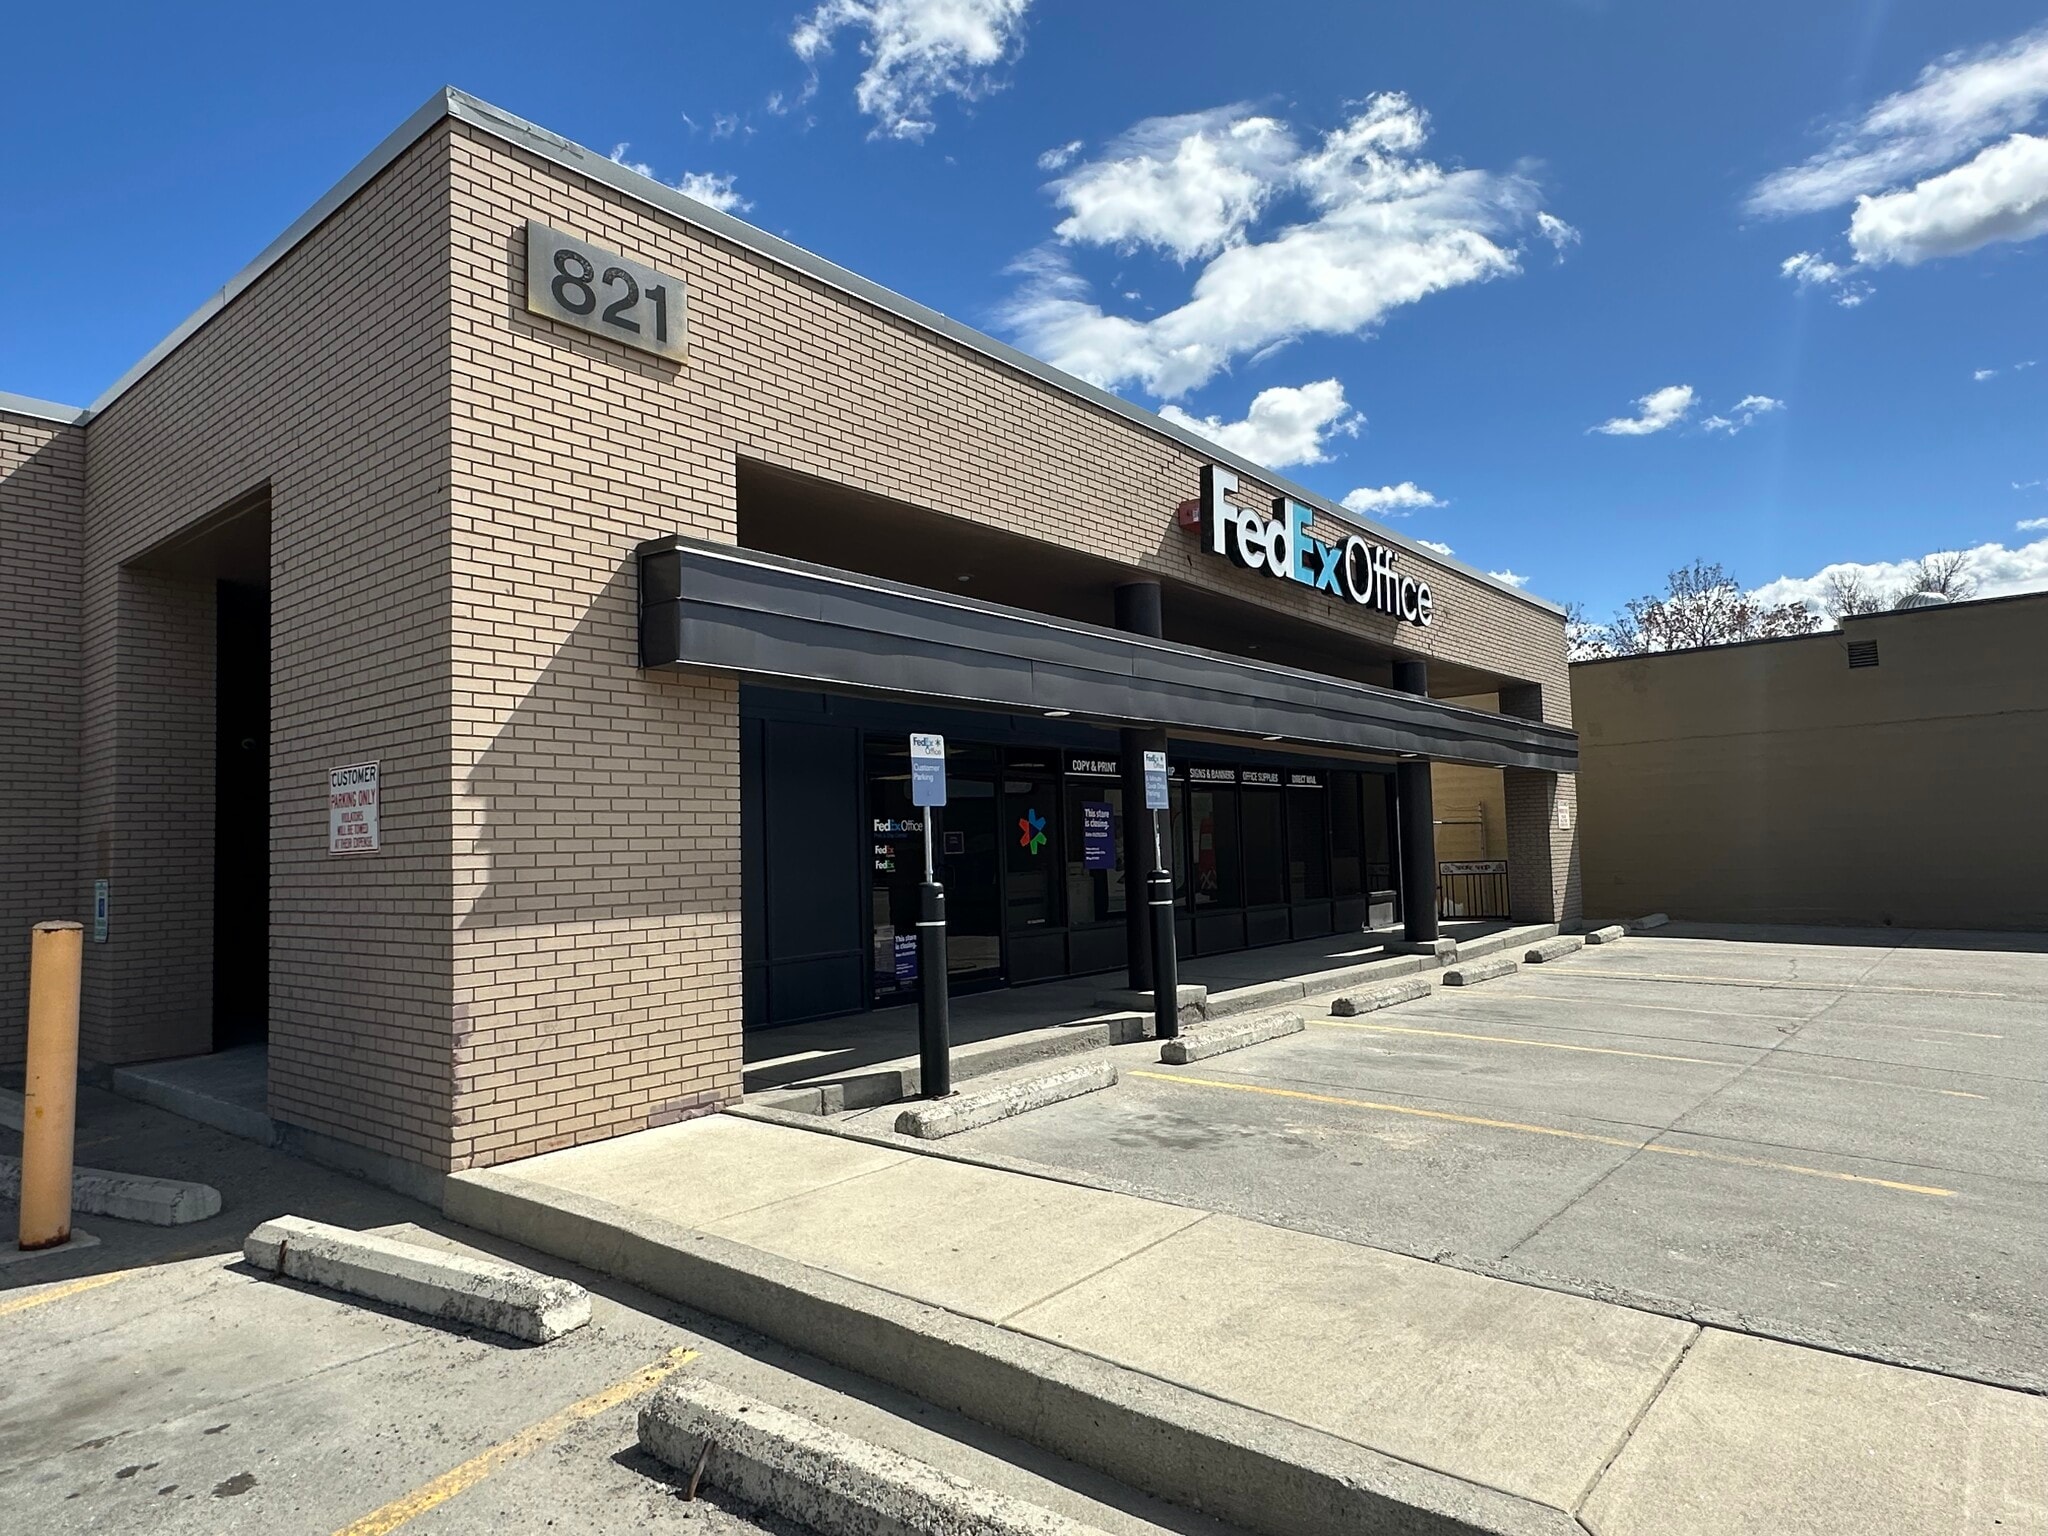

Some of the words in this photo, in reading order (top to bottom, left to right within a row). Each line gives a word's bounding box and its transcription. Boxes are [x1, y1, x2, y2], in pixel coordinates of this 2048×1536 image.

[551, 249, 668, 344] 821
[1072, 759, 1090, 771] COPY
[1091, 760, 1097, 771] &
[1097, 761, 1117, 772] PRINT
[332, 766, 376, 787] CUSTOMER
[1190, 768, 1206, 779] SIGNS
[1211, 769, 1235, 780] BANNERS
[1242, 771, 1257, 781] OFFICE
[331, 791, 356, 809] PARKING
[358, 788, 376, 806] ONLY
[1084, 808, 1096, 818] This
[1096, 809, 1110, 819] store
[874, 819, 900, 832] FedEx
[900, 820, 923, 832] Office
[1084, 818, 1090, 828] is
[1090, 818, 1110, 830] closing.
